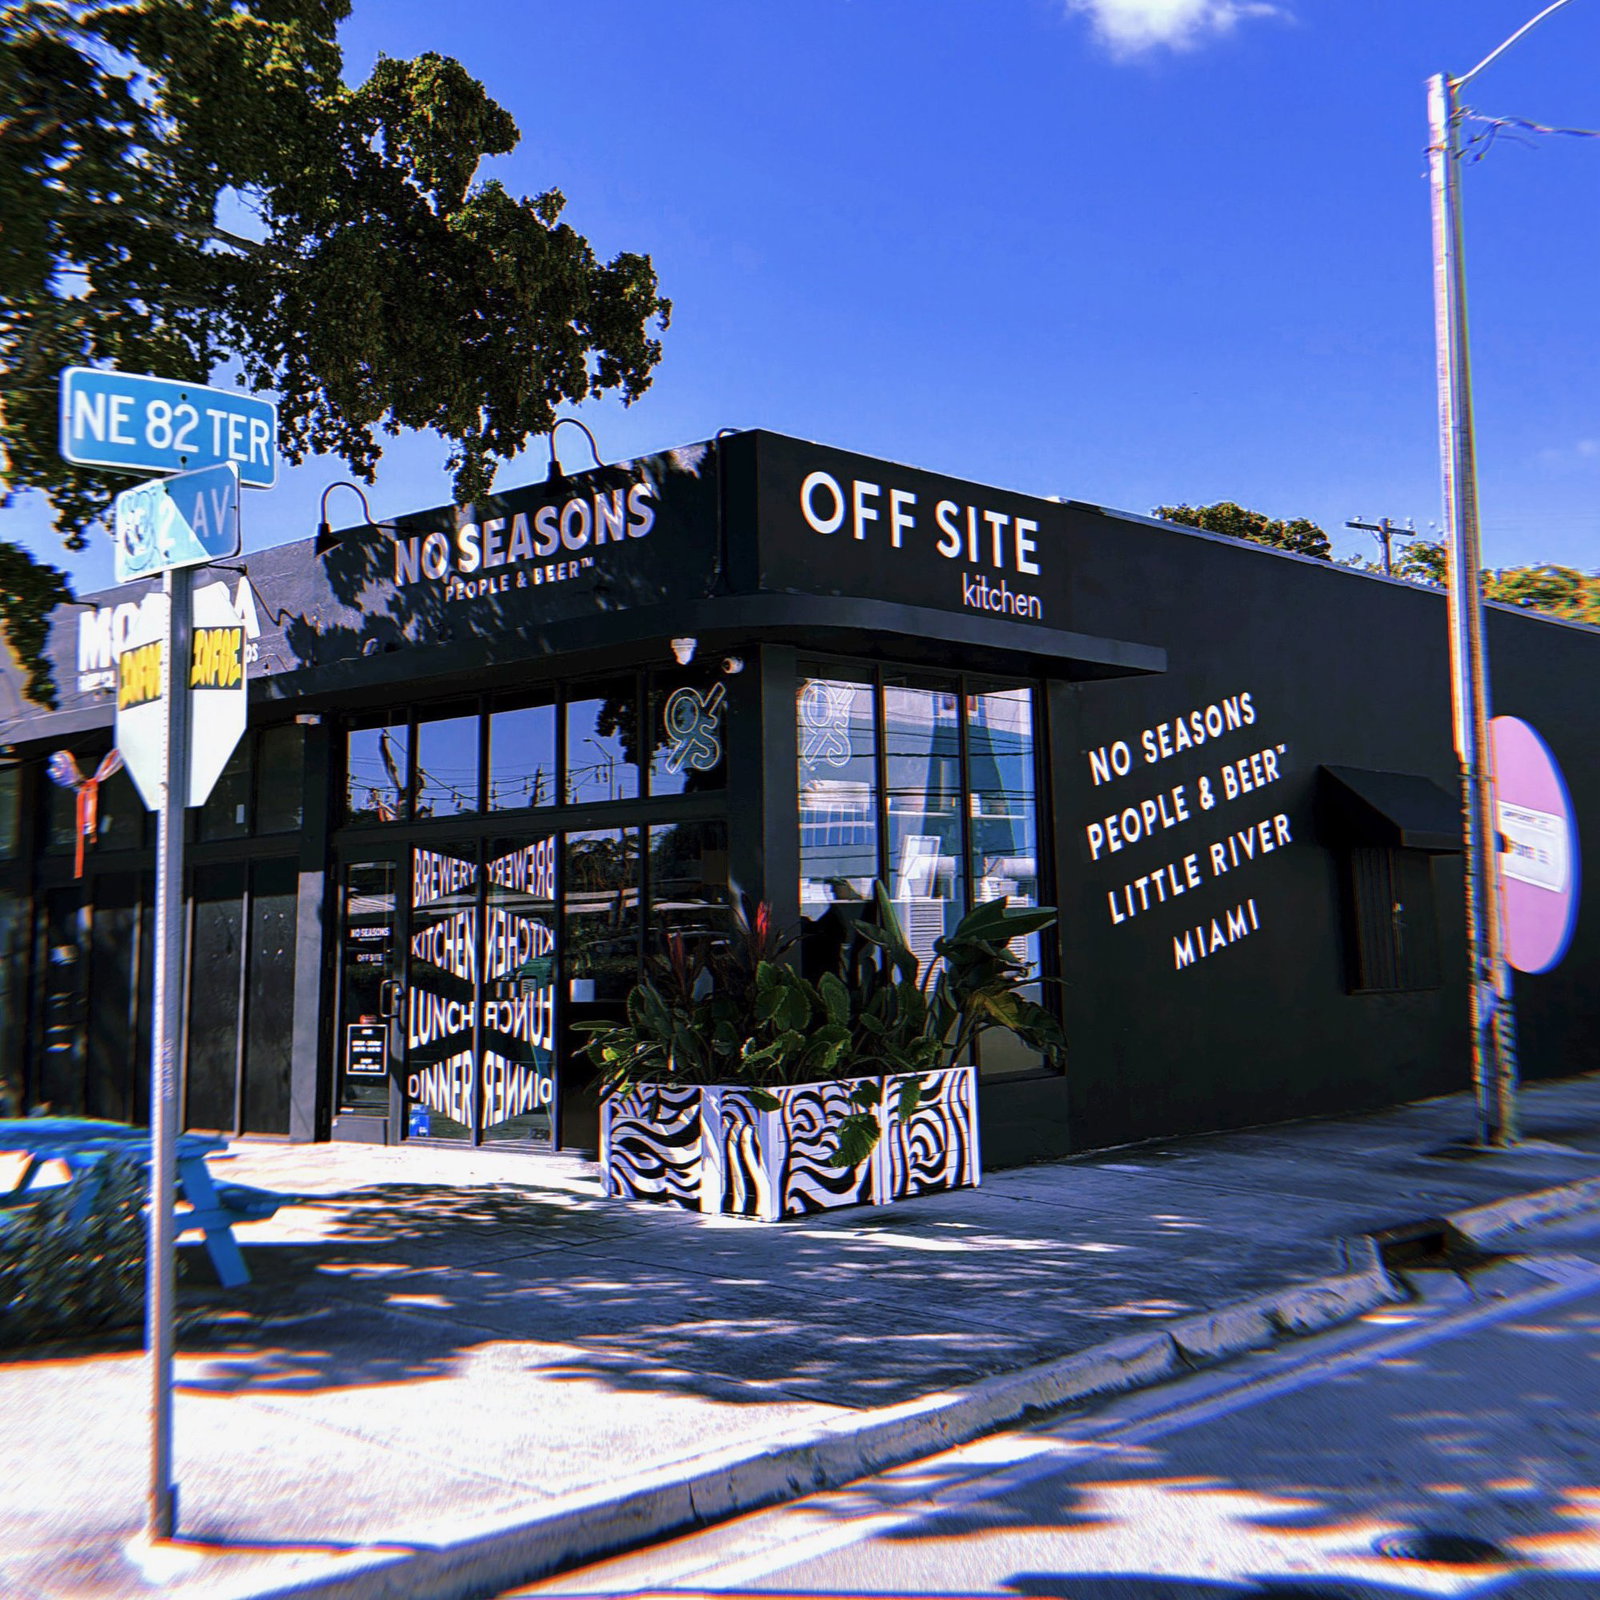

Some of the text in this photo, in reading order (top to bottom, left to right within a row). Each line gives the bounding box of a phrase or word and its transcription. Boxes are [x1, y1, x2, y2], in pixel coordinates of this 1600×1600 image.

[73, 389, 270, 466] NE 82 TER
[191, 485, 230, 538] AV
[394, 483, 656, 587] NO SEASONS
[800, 471, 1040, 576] OFF SITE
[445, 574, 510, 602] PEOPLE
[515, 571, 528, 588] &
[962, 572, 1042, 619] kitchen
[1088, 692, 1256, 786] NO SEASONS
[1086, 785, 1190, 861] PEOPLE
[1198, 776, 1215, 810] &
[413, 847, 478, 908] BREWERY
[1107, 813, 1293, 925] LITTLE RIVER
[411, 907, 477, 984] KITCHEN
[1173, 899, 1260, 970] MIAMI
[408, 986, 475, 1049] LUNCH
[408, 1050, 473, 1129] DINNER
